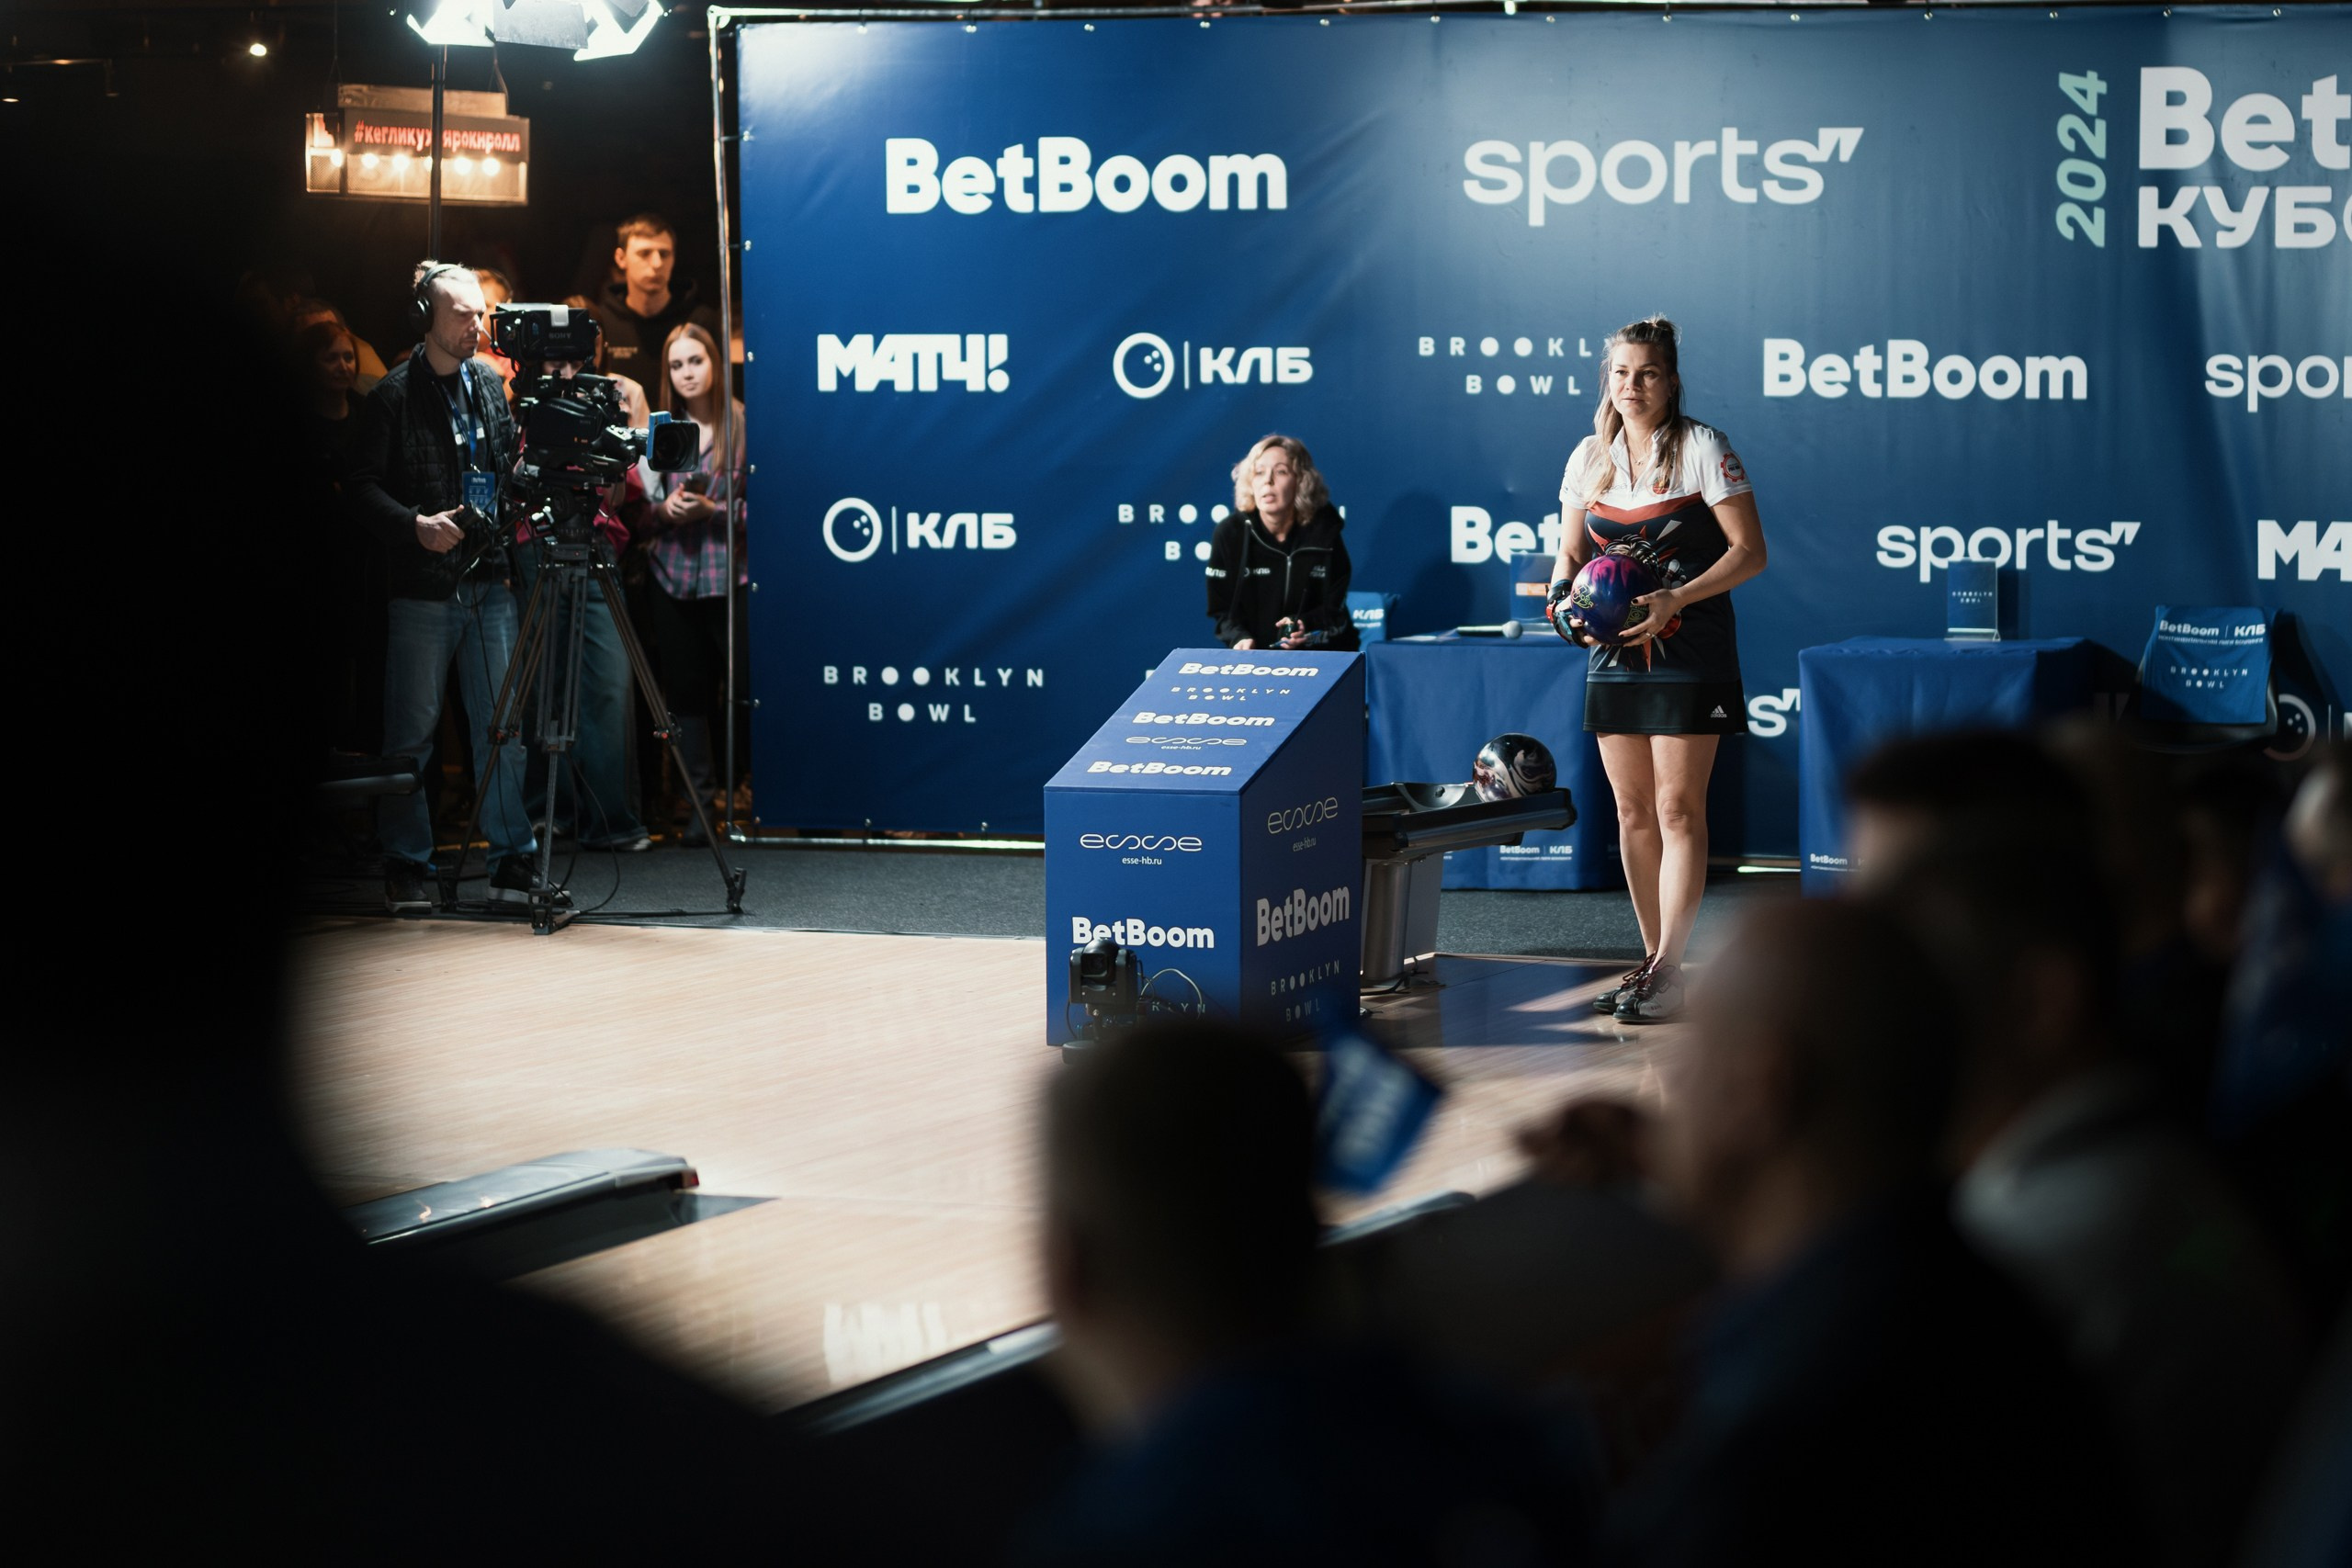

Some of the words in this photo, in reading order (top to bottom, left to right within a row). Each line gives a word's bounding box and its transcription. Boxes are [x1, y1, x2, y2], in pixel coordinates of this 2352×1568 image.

[2056, 71, 2107, 247] 2024
[886, 137, 1286, 214] BetBoom
[2139, 186, 2352, 248] КУБ
[1419, 337, 1591, 356] BROOKL
[818, 334, 1009, 392] МАТЧ!
[1200, 347, 1312, 383] КЛБ
[1763, 338, 2086, 400] BetBoom
[1466, 375, 1580, 394] BOWL
[908, 513, 1016, 548] КЛБ
[2160, 620, 2219, 636] BetBoom
[2234, 625, 2265, 636] КЛБ
[825, 666, 1043, 686] BROOKLYN
[1179, 662, 1319, 677] BetBoom
[2170, 666, 2248, 677] BROOKLYN
[2186, 680, 2223, 689] BOWL
[869, 704, 975, 722] BOWL
[1133, 712, 1274, 726] BetBoom
[1087, 761, 1231, 775] BetBoom
[1293, 837, 1317, 852] esse-hb.ru
[1499, 844, 1541, 854] BetBoom
[1122, 856, 1162, 865] esse-hb.ru
[1257, 886, 1349, 946] BetBoom
[1072, 917, 1215, 949] BetBoom
[1271, 960, 1340, 996] BROOKLYN
